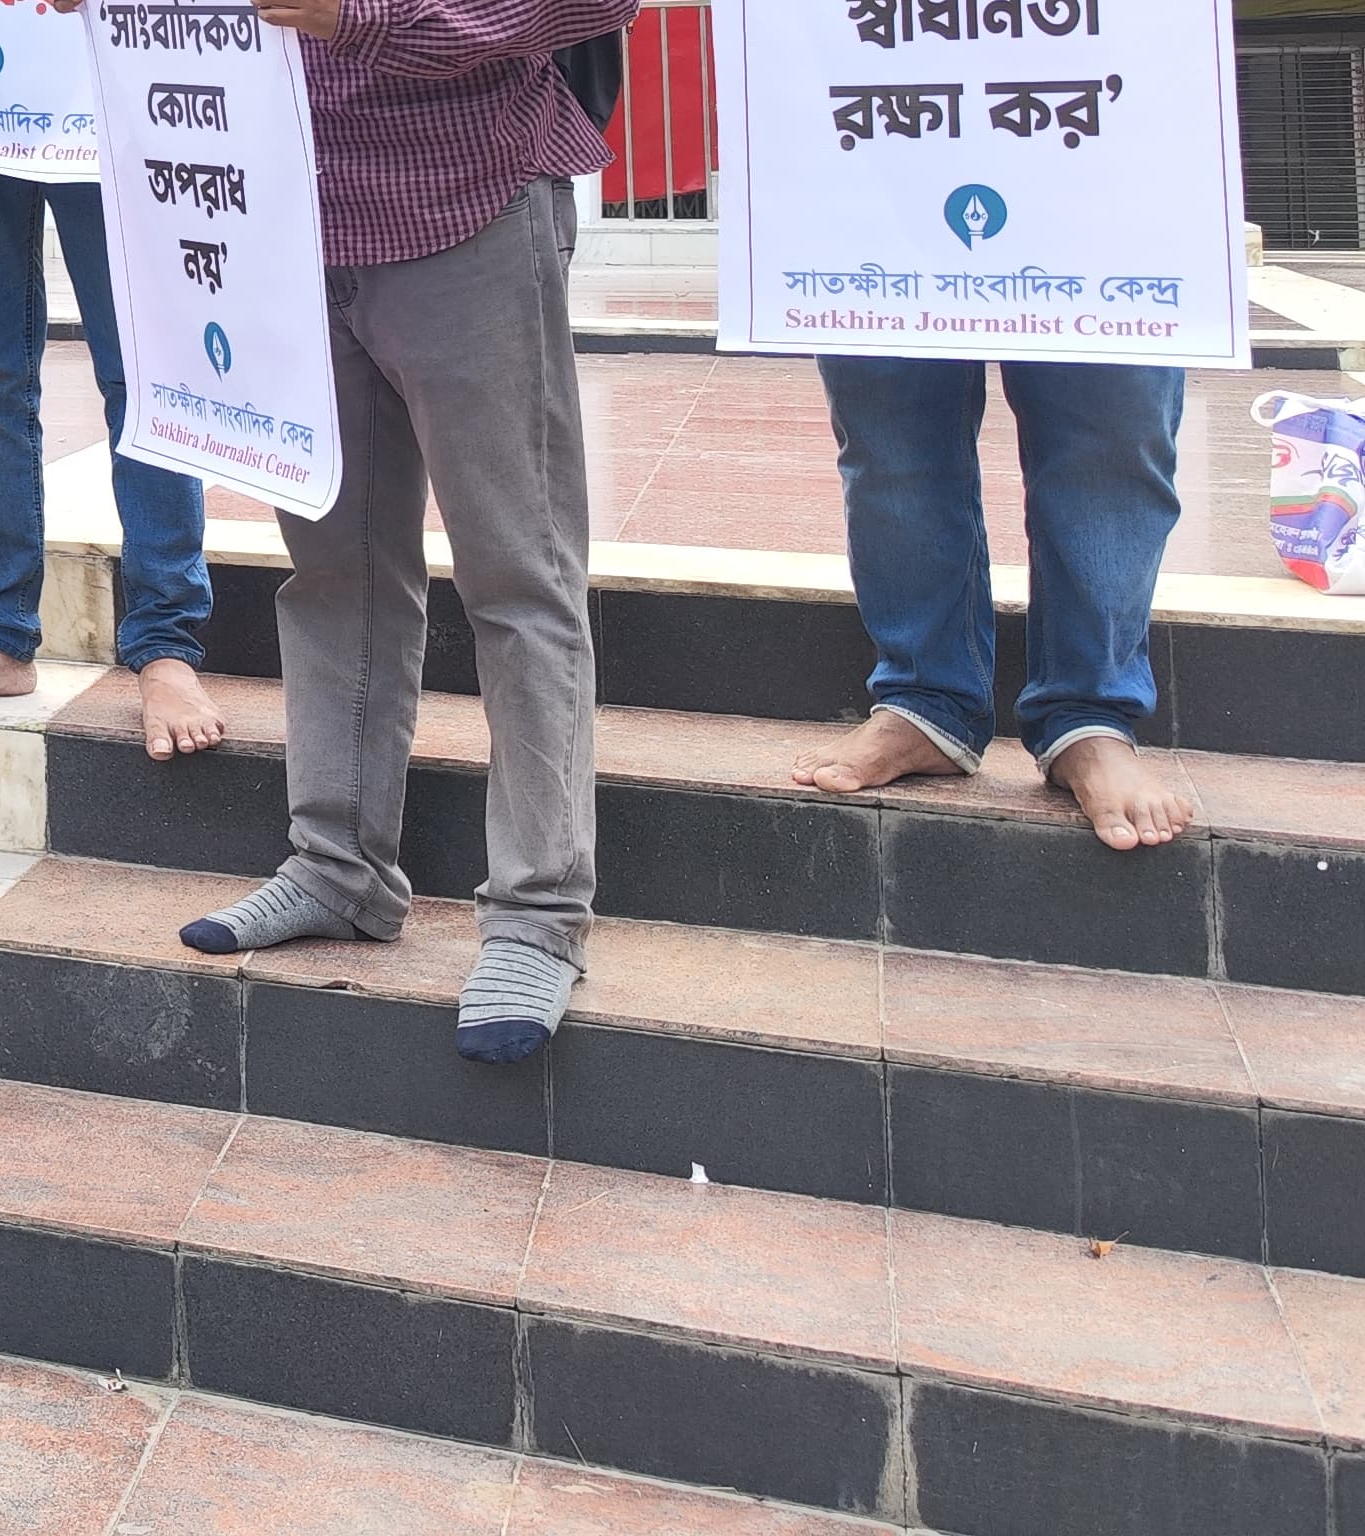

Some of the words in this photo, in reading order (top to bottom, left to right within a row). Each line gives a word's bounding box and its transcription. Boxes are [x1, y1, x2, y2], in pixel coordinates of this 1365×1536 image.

[147, 82, 228, 132] কোনো
[829, 83, 963, 151] রক্ষা
[985, 73, 1123, 150] কর’
[145, 158, 247, 218] অপরাধ
[179, 239, 227, 295] নয়’
[782, 262, 922, 300] সাতক্ষীরা
[934, 265, 1086, 303] সাংবাদিক
[1099, 275, 1183, 307] কেন্দ্র
[785, 306, 905, 332] Satkhira
[915, 309, 1063, 335] Journalist
[1073, 314, 1179, 339] Center
[151, 381, 207, 422] সাতক্ষীরা
[211, 397, 275, 438] সাংবাদিক
[280, 419, 314, 456] কেন্দ্র
[150, 416, 199, 449] Satkhira
[201, 431, 264, 472] Journalist
[266, 452, 310, 483] Center
